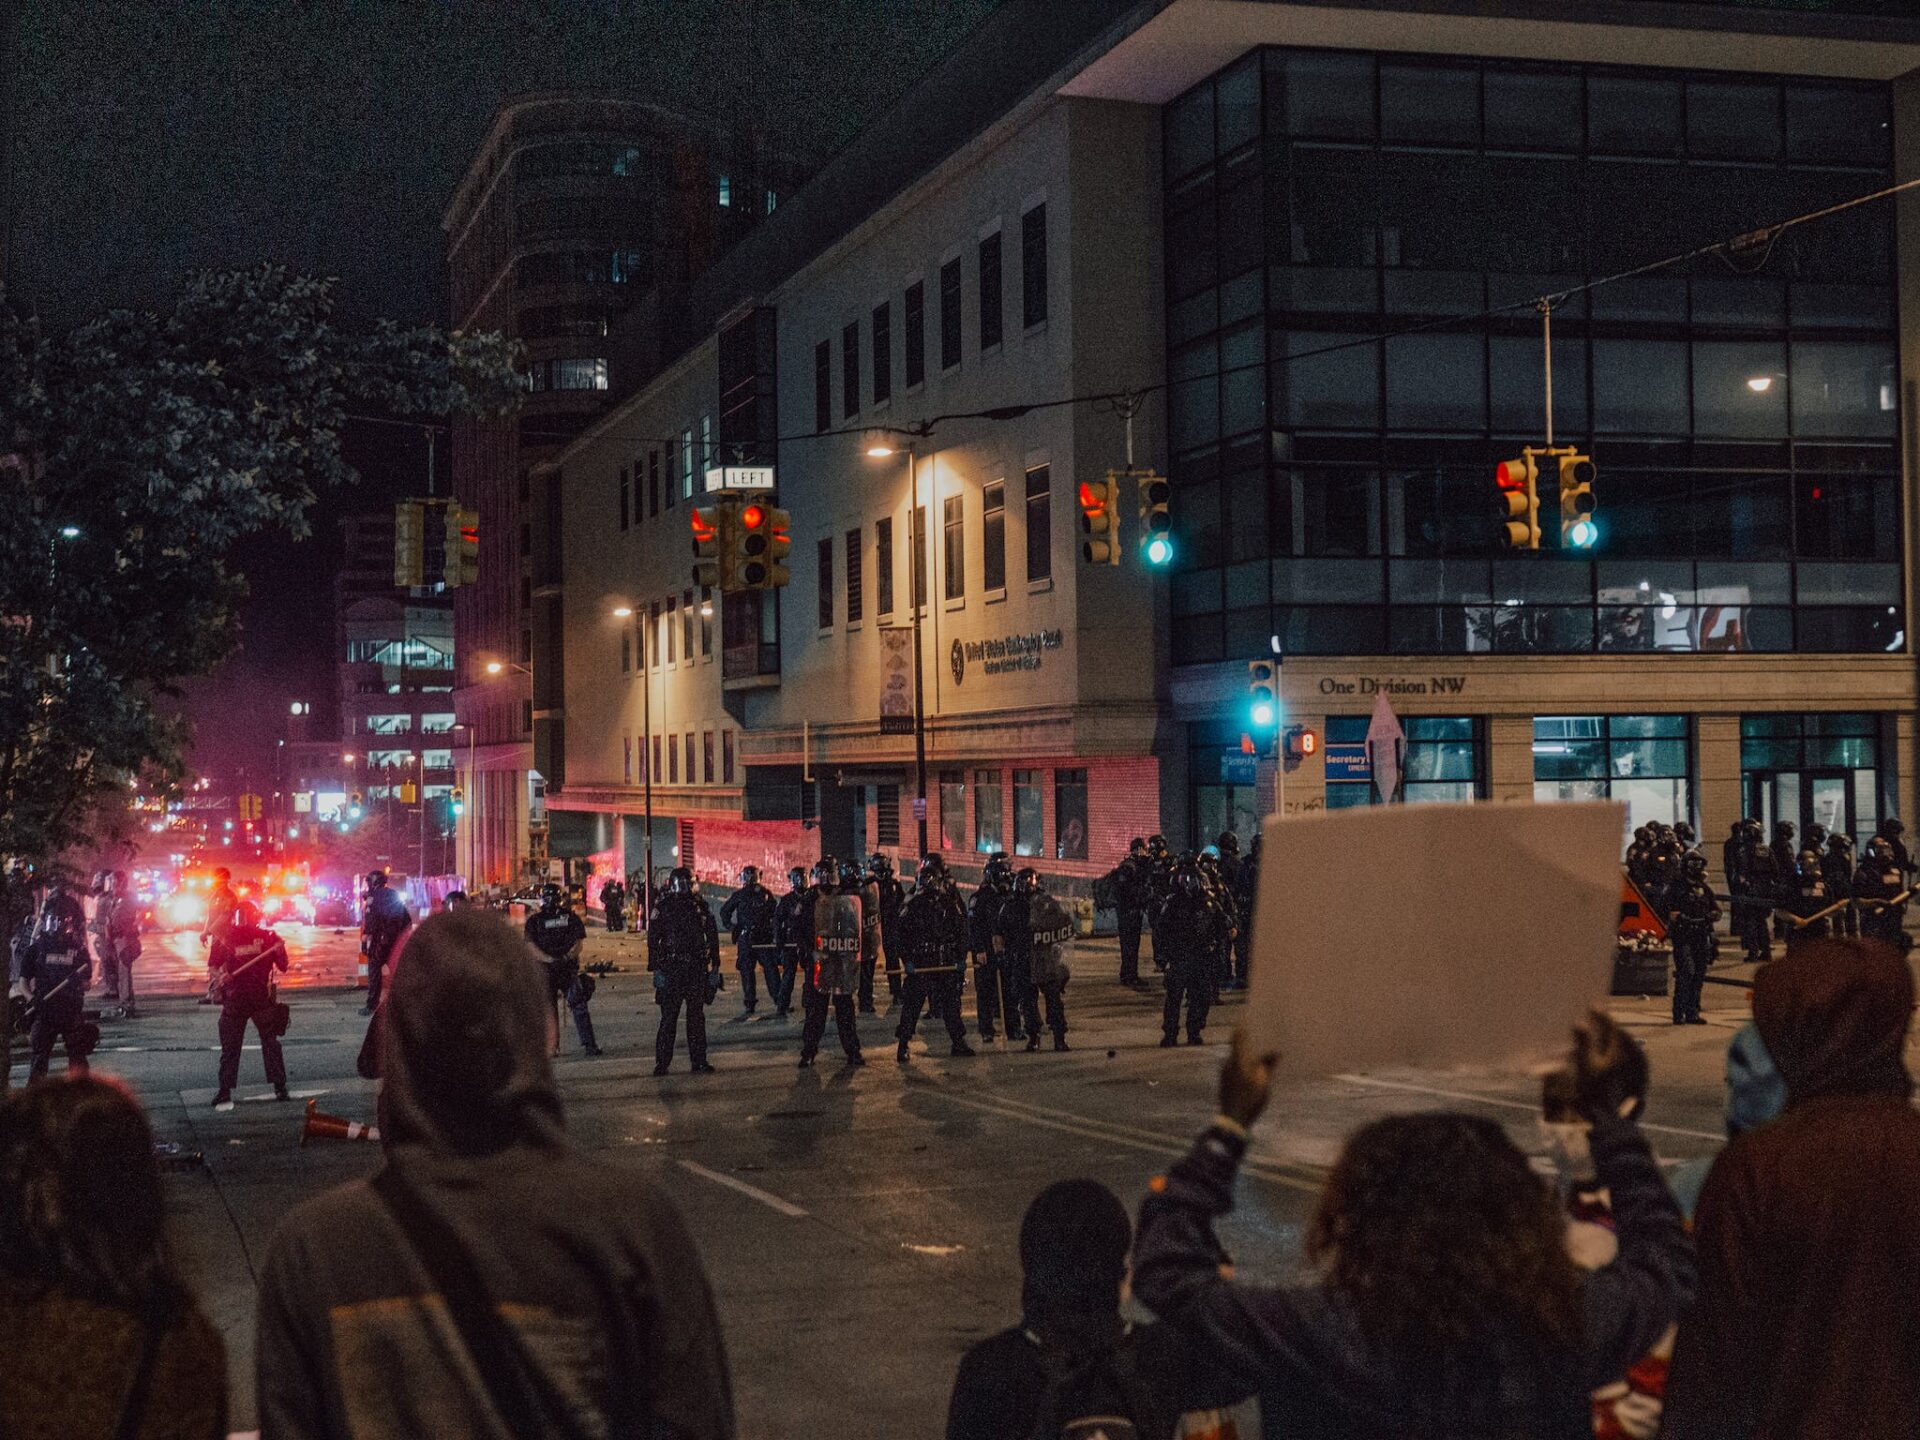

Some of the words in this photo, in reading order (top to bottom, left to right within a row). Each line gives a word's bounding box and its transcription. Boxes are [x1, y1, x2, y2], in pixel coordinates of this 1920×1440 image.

[732, 471, 765, 485] LEFT
[1320, 677, 1355, 694] One
[1360, 677, 1426, 694] Division
[1431, 677, 1466, 694] NW
[1033, 924, 1073, 945] POLICE
[819, 937, 859, 951] POLICE
